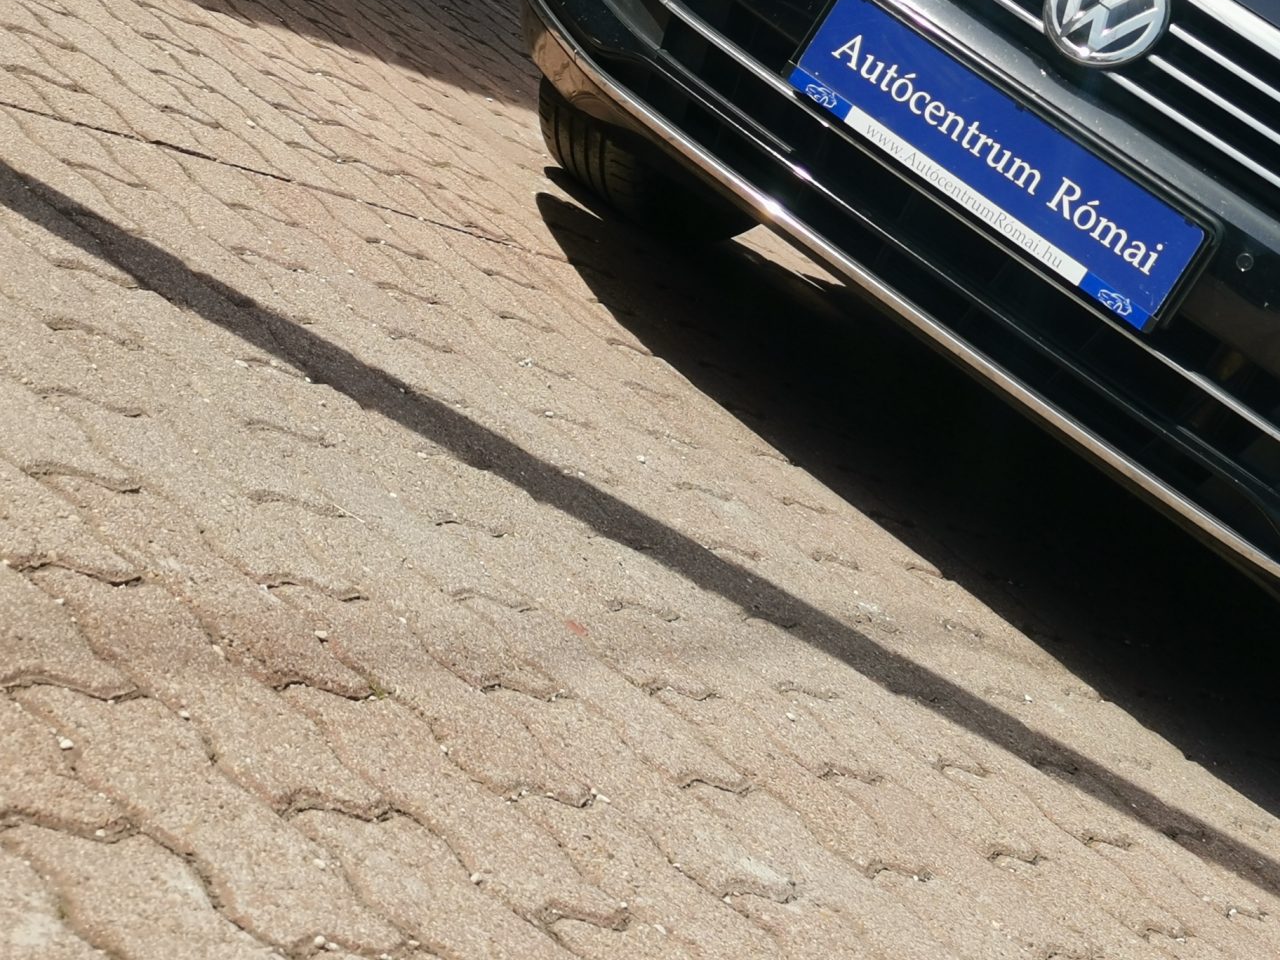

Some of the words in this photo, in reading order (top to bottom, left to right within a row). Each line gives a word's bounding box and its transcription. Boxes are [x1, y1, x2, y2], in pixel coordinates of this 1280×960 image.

[832, 33, 1042, 195] Autócentrum
[1046, 176, 1164, 275] Római
[866, 123, 1063, 270] www.AutócentrumRómai.hu
